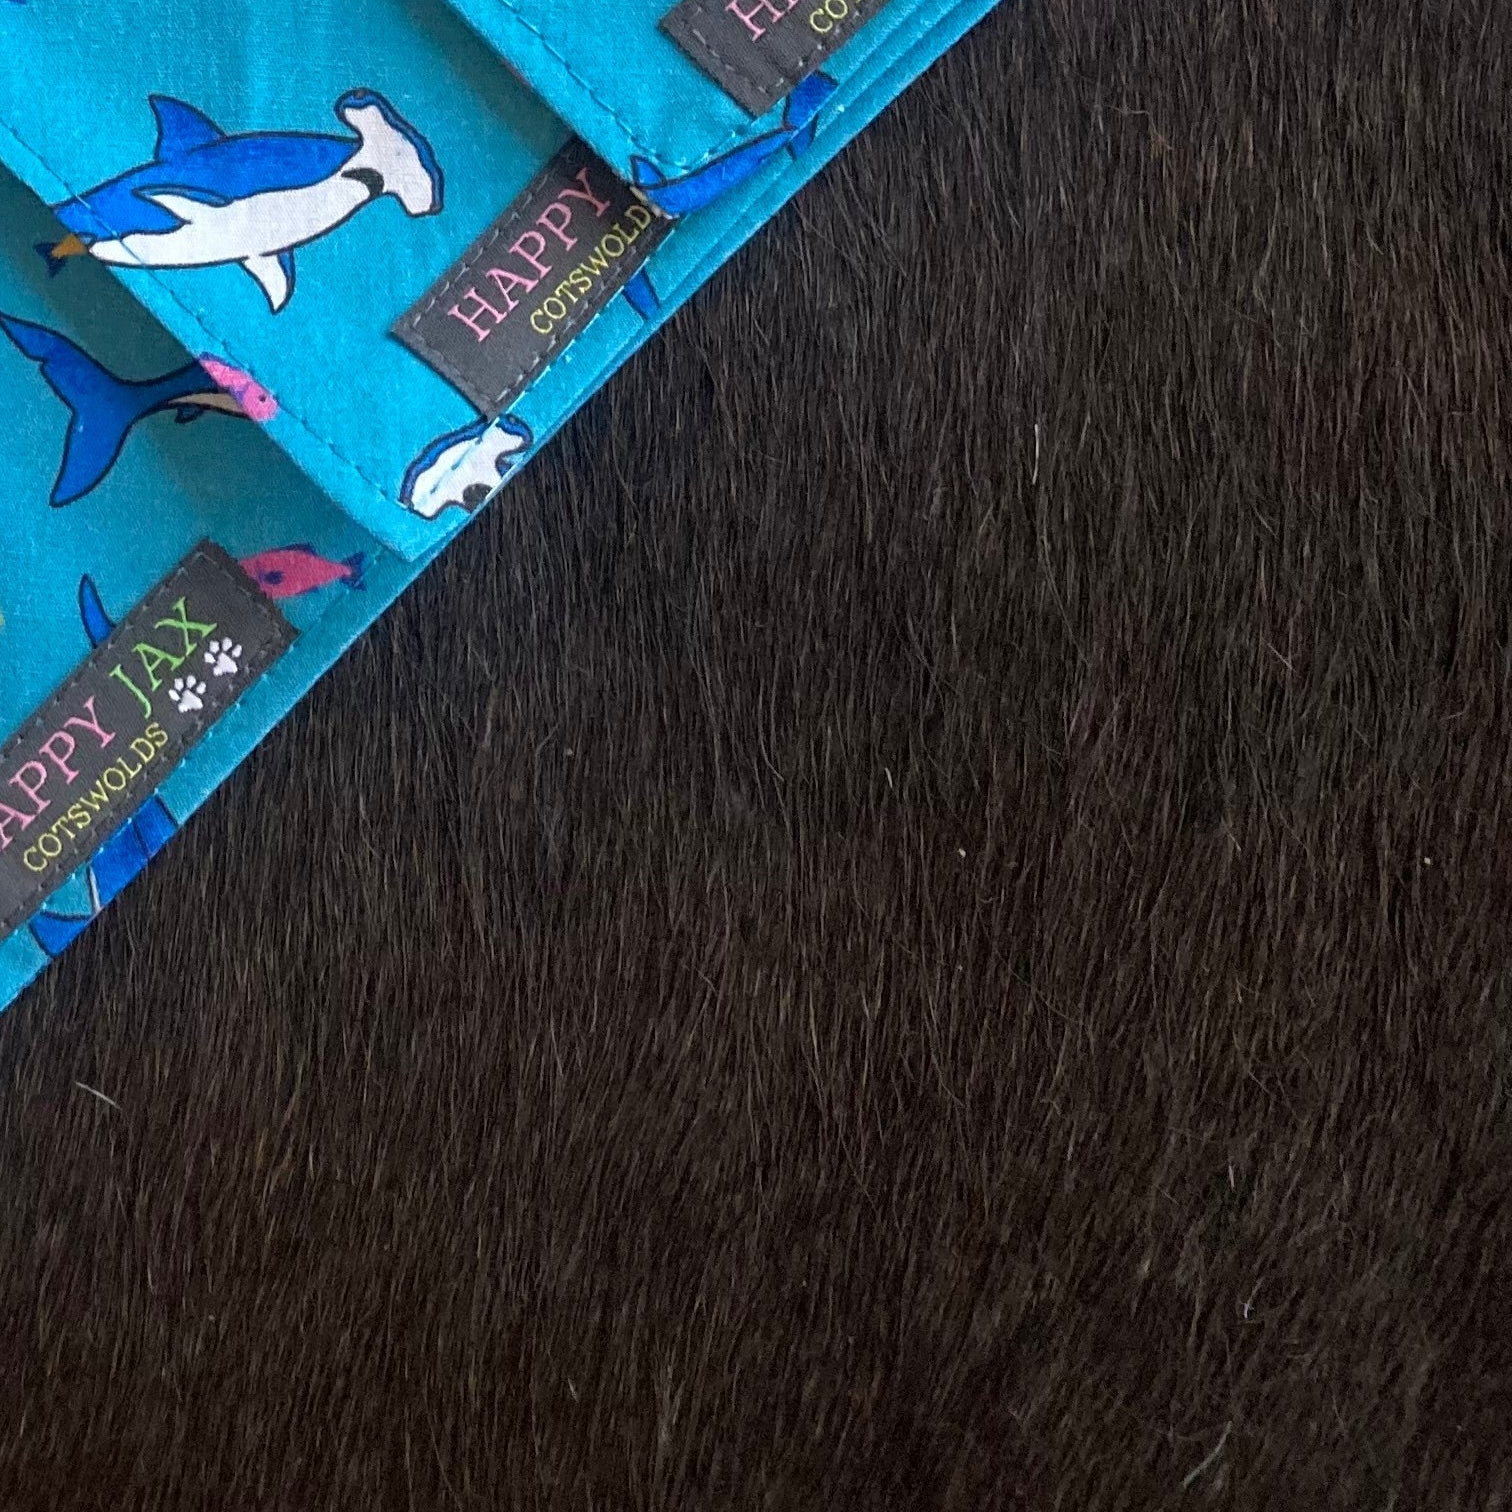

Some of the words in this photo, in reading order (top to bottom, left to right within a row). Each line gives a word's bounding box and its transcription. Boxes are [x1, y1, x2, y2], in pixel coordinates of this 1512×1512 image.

[447, 167, 610, 342] HAPPY
[109, 596, 217, 719] JAX
[23, 722, 168, 873] COTSWOLDS
